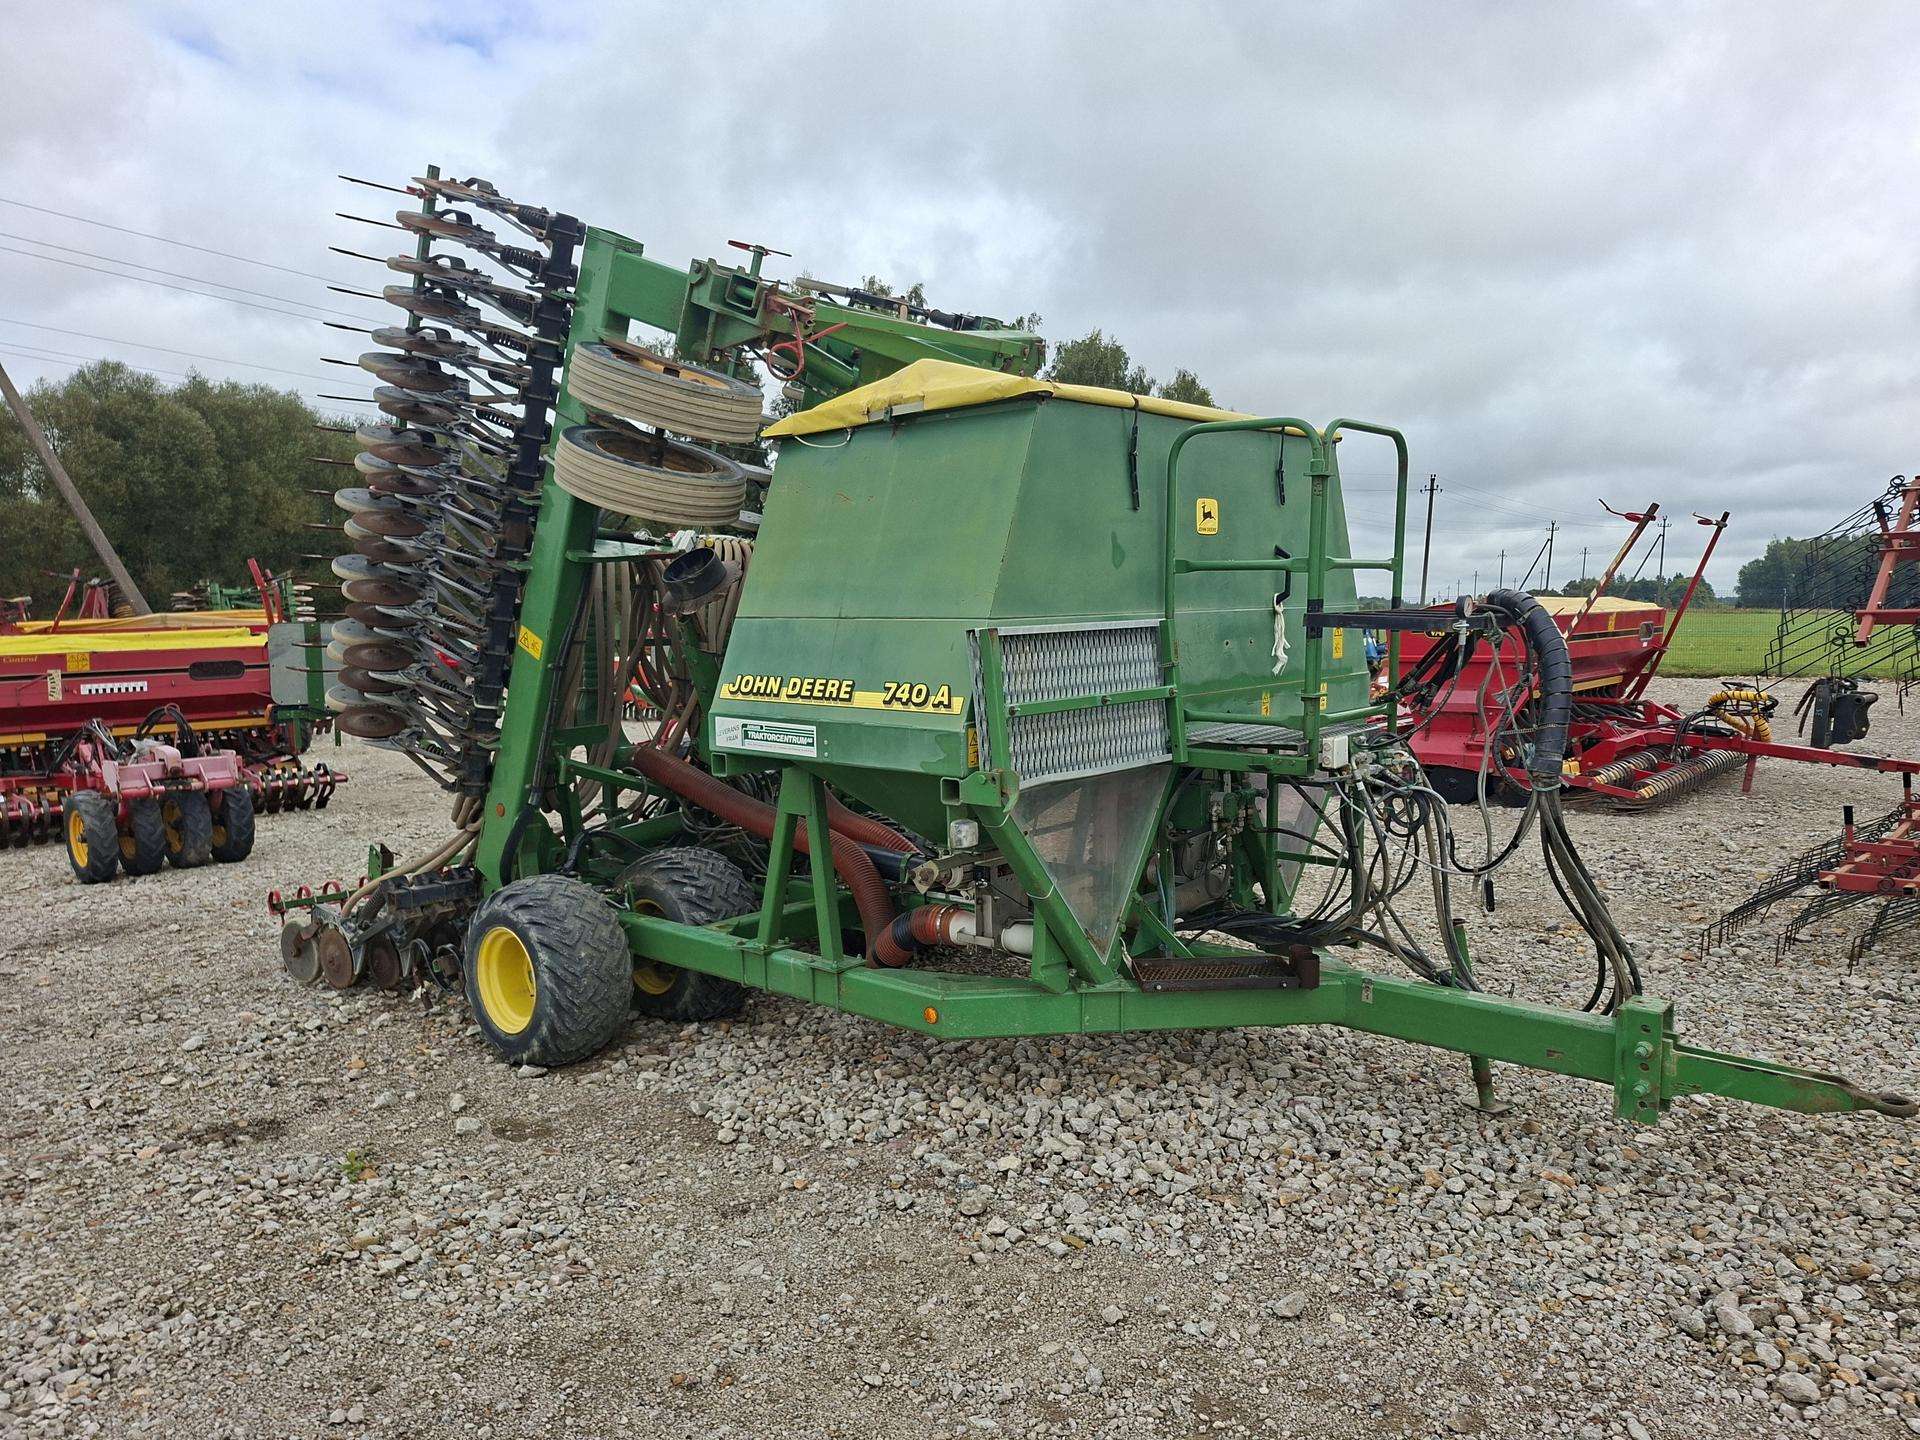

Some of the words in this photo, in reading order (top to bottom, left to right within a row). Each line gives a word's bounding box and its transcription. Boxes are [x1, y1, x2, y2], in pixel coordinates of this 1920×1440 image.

[727, 674, 783, 698] JOHN
[785, 677, 855, 702] DEERE
[882, 681, 930, 706] 740
[932, 684, 952, 708] A
[747, 731, 808, 745] TRAKTORCENTRUM
